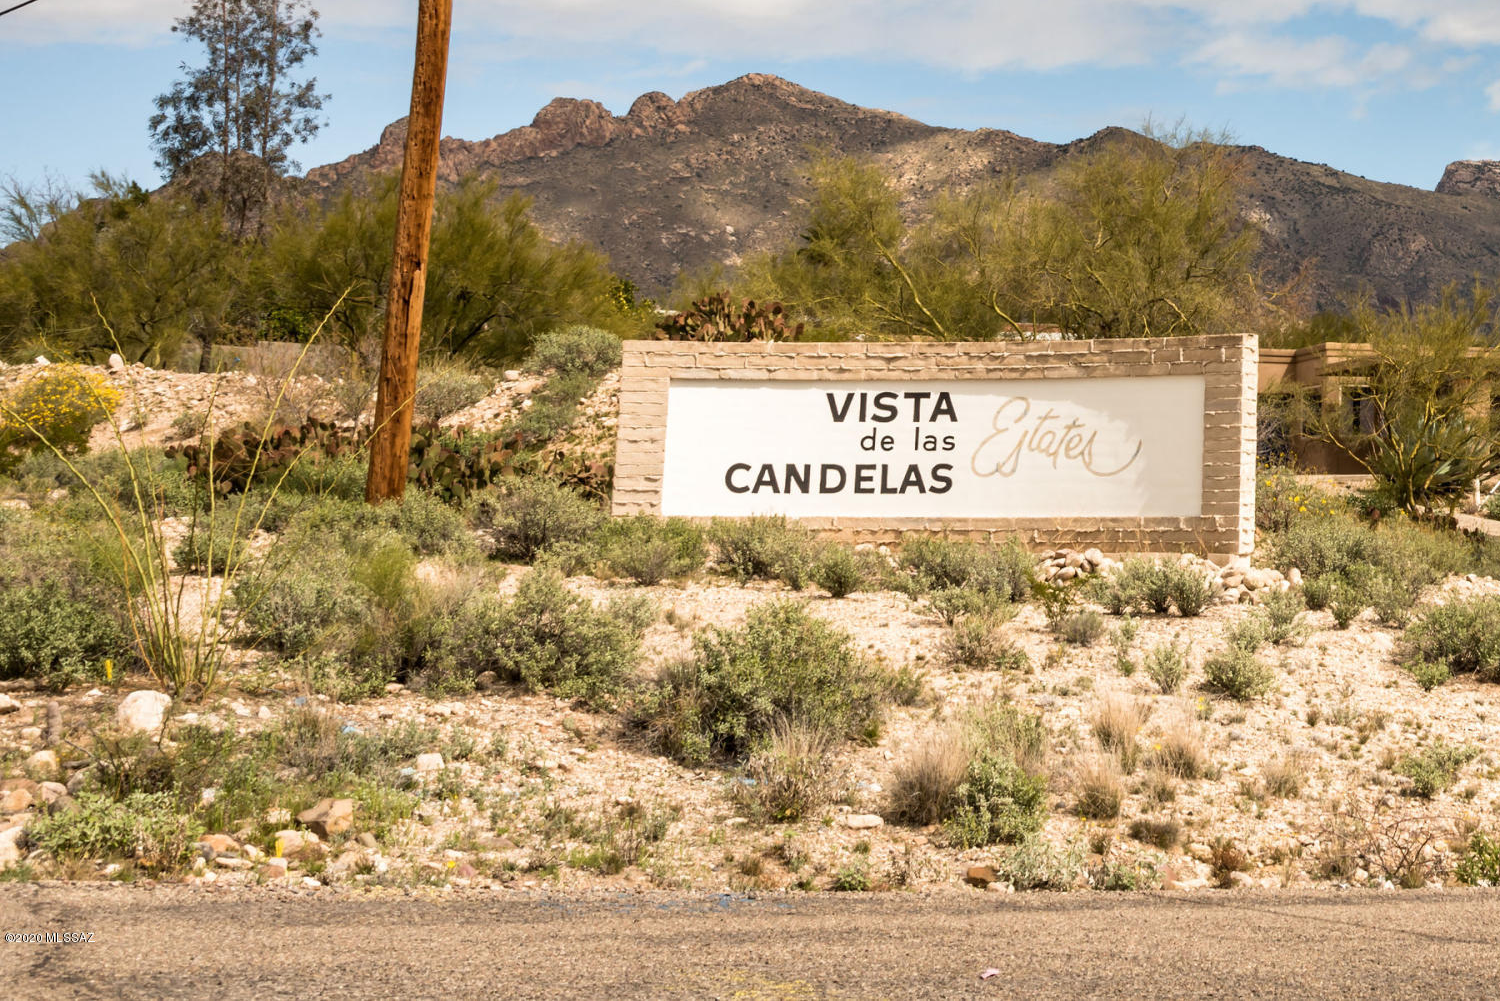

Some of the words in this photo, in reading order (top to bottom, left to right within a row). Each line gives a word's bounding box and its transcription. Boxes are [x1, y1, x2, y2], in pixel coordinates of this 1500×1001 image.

[826, 391, 958, 423] VISTA
[860, 427, 895, 452] de
[914, 426, 956, 452] las
[971, 396, 1142, 477] Estates
[724, 462, 954, 495] CANDELAS
